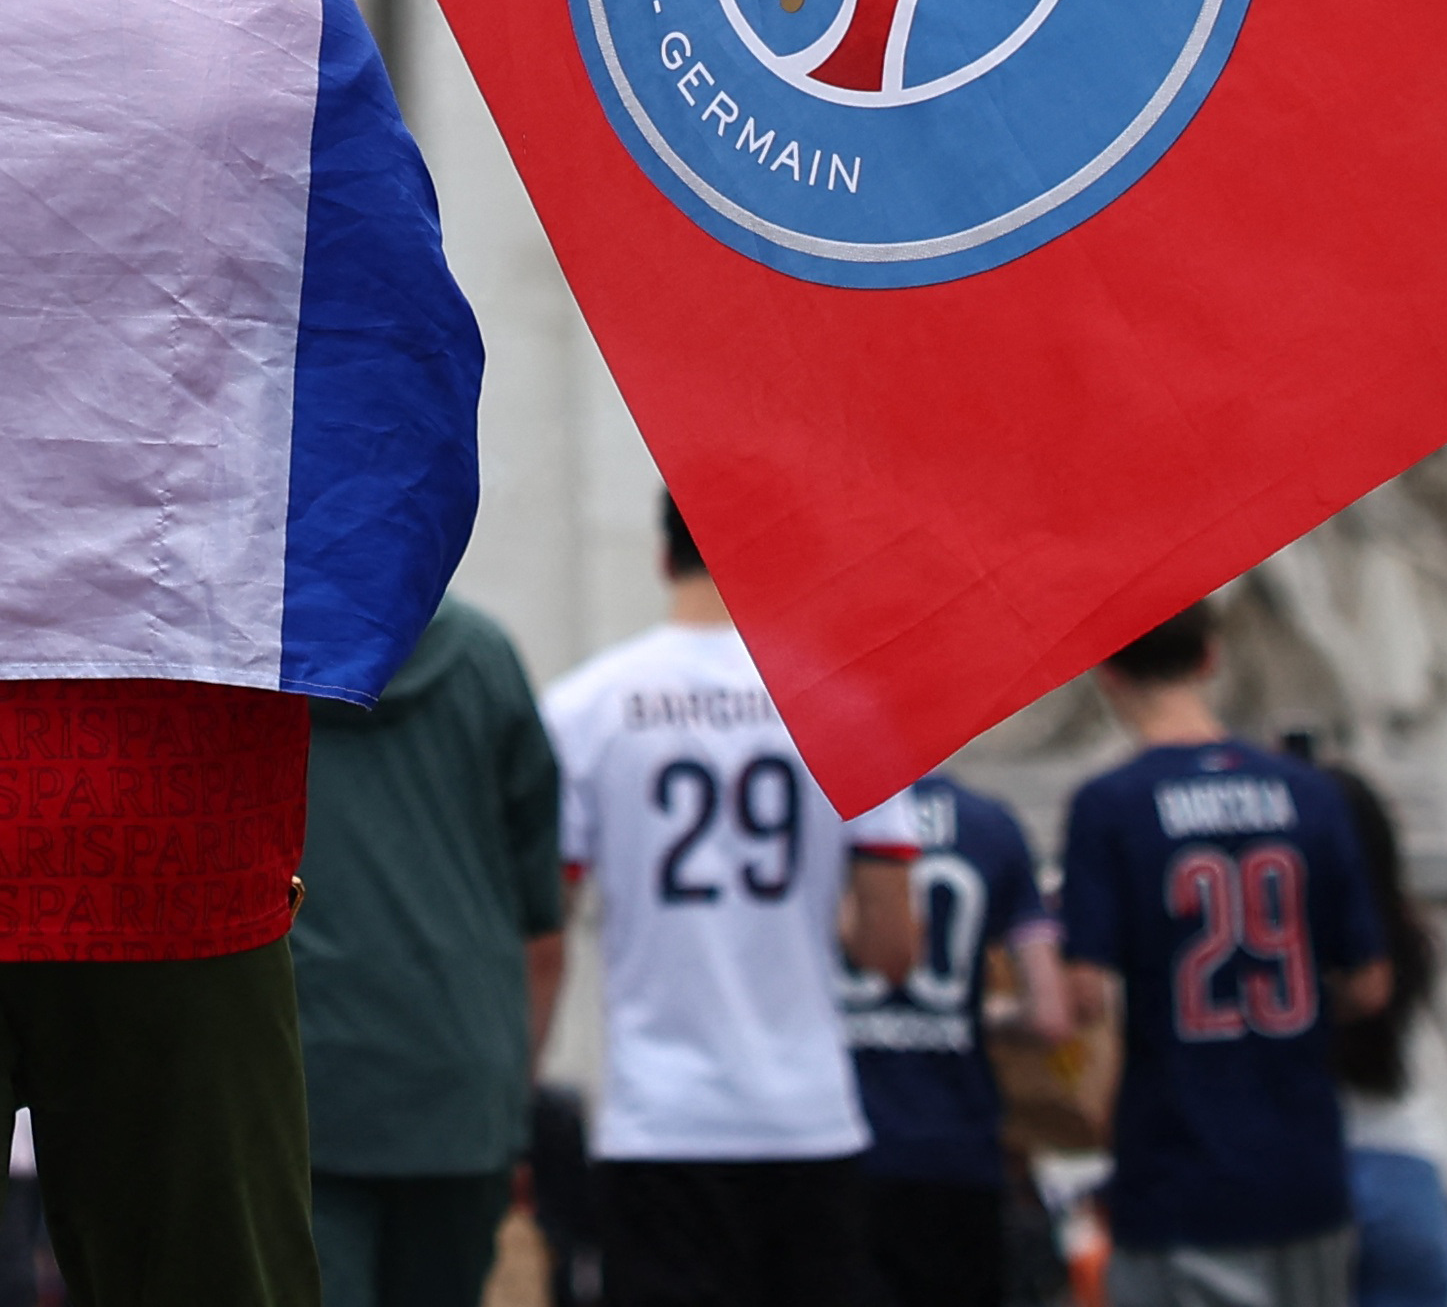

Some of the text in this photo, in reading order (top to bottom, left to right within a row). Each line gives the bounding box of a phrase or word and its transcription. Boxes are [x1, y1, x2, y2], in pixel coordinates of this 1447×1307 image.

[659, 29, 862, 194] GERMAIN
[28, 763, 196, 819] PARIS
[652, 753, 801, 905] 29
[28, 881, 198, 937] PARIS
[1166, 845, 1318, 1042] 29
